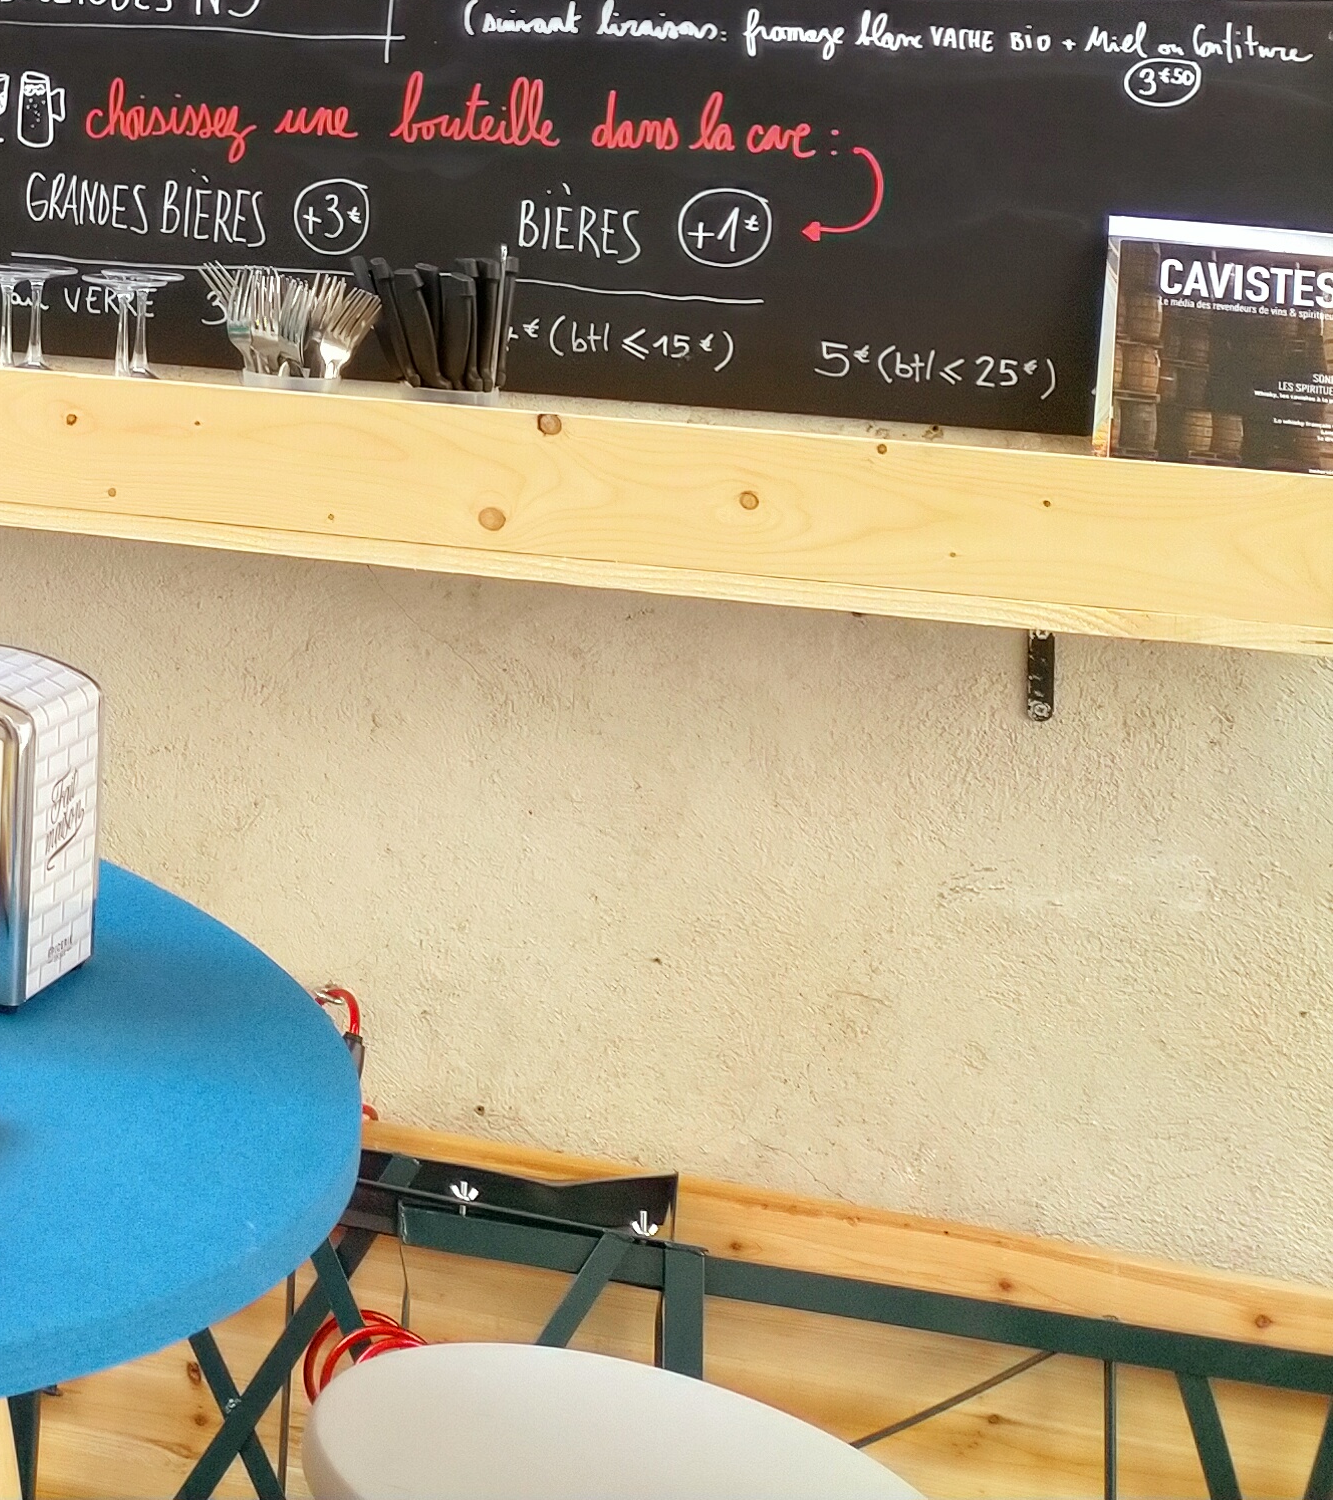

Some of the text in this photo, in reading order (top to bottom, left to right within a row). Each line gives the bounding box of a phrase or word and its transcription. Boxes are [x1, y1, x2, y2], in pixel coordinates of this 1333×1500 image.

[1083, 21, 1147, 59] Miel
[85, 69, 742, 164] choisissez une bouteille dans la
[25, 171, 148, 235] GRANDES
[159, 166, 267, 248] BIÈRES
[515, 183, 645, 266] BIÈRES
[1159, 258, 1333, 309] CAVISTES
[1196, 301, 1211, 310] des
[1212, 303, 1257, 314] revendeurs
[1258, 306, 1269, 315] de
[1271, 307, 1287, 316] vins
[1299, 310, 1333, 320] spiritueu
[1278, 381, 1333, 395] LES SPIRITUE
